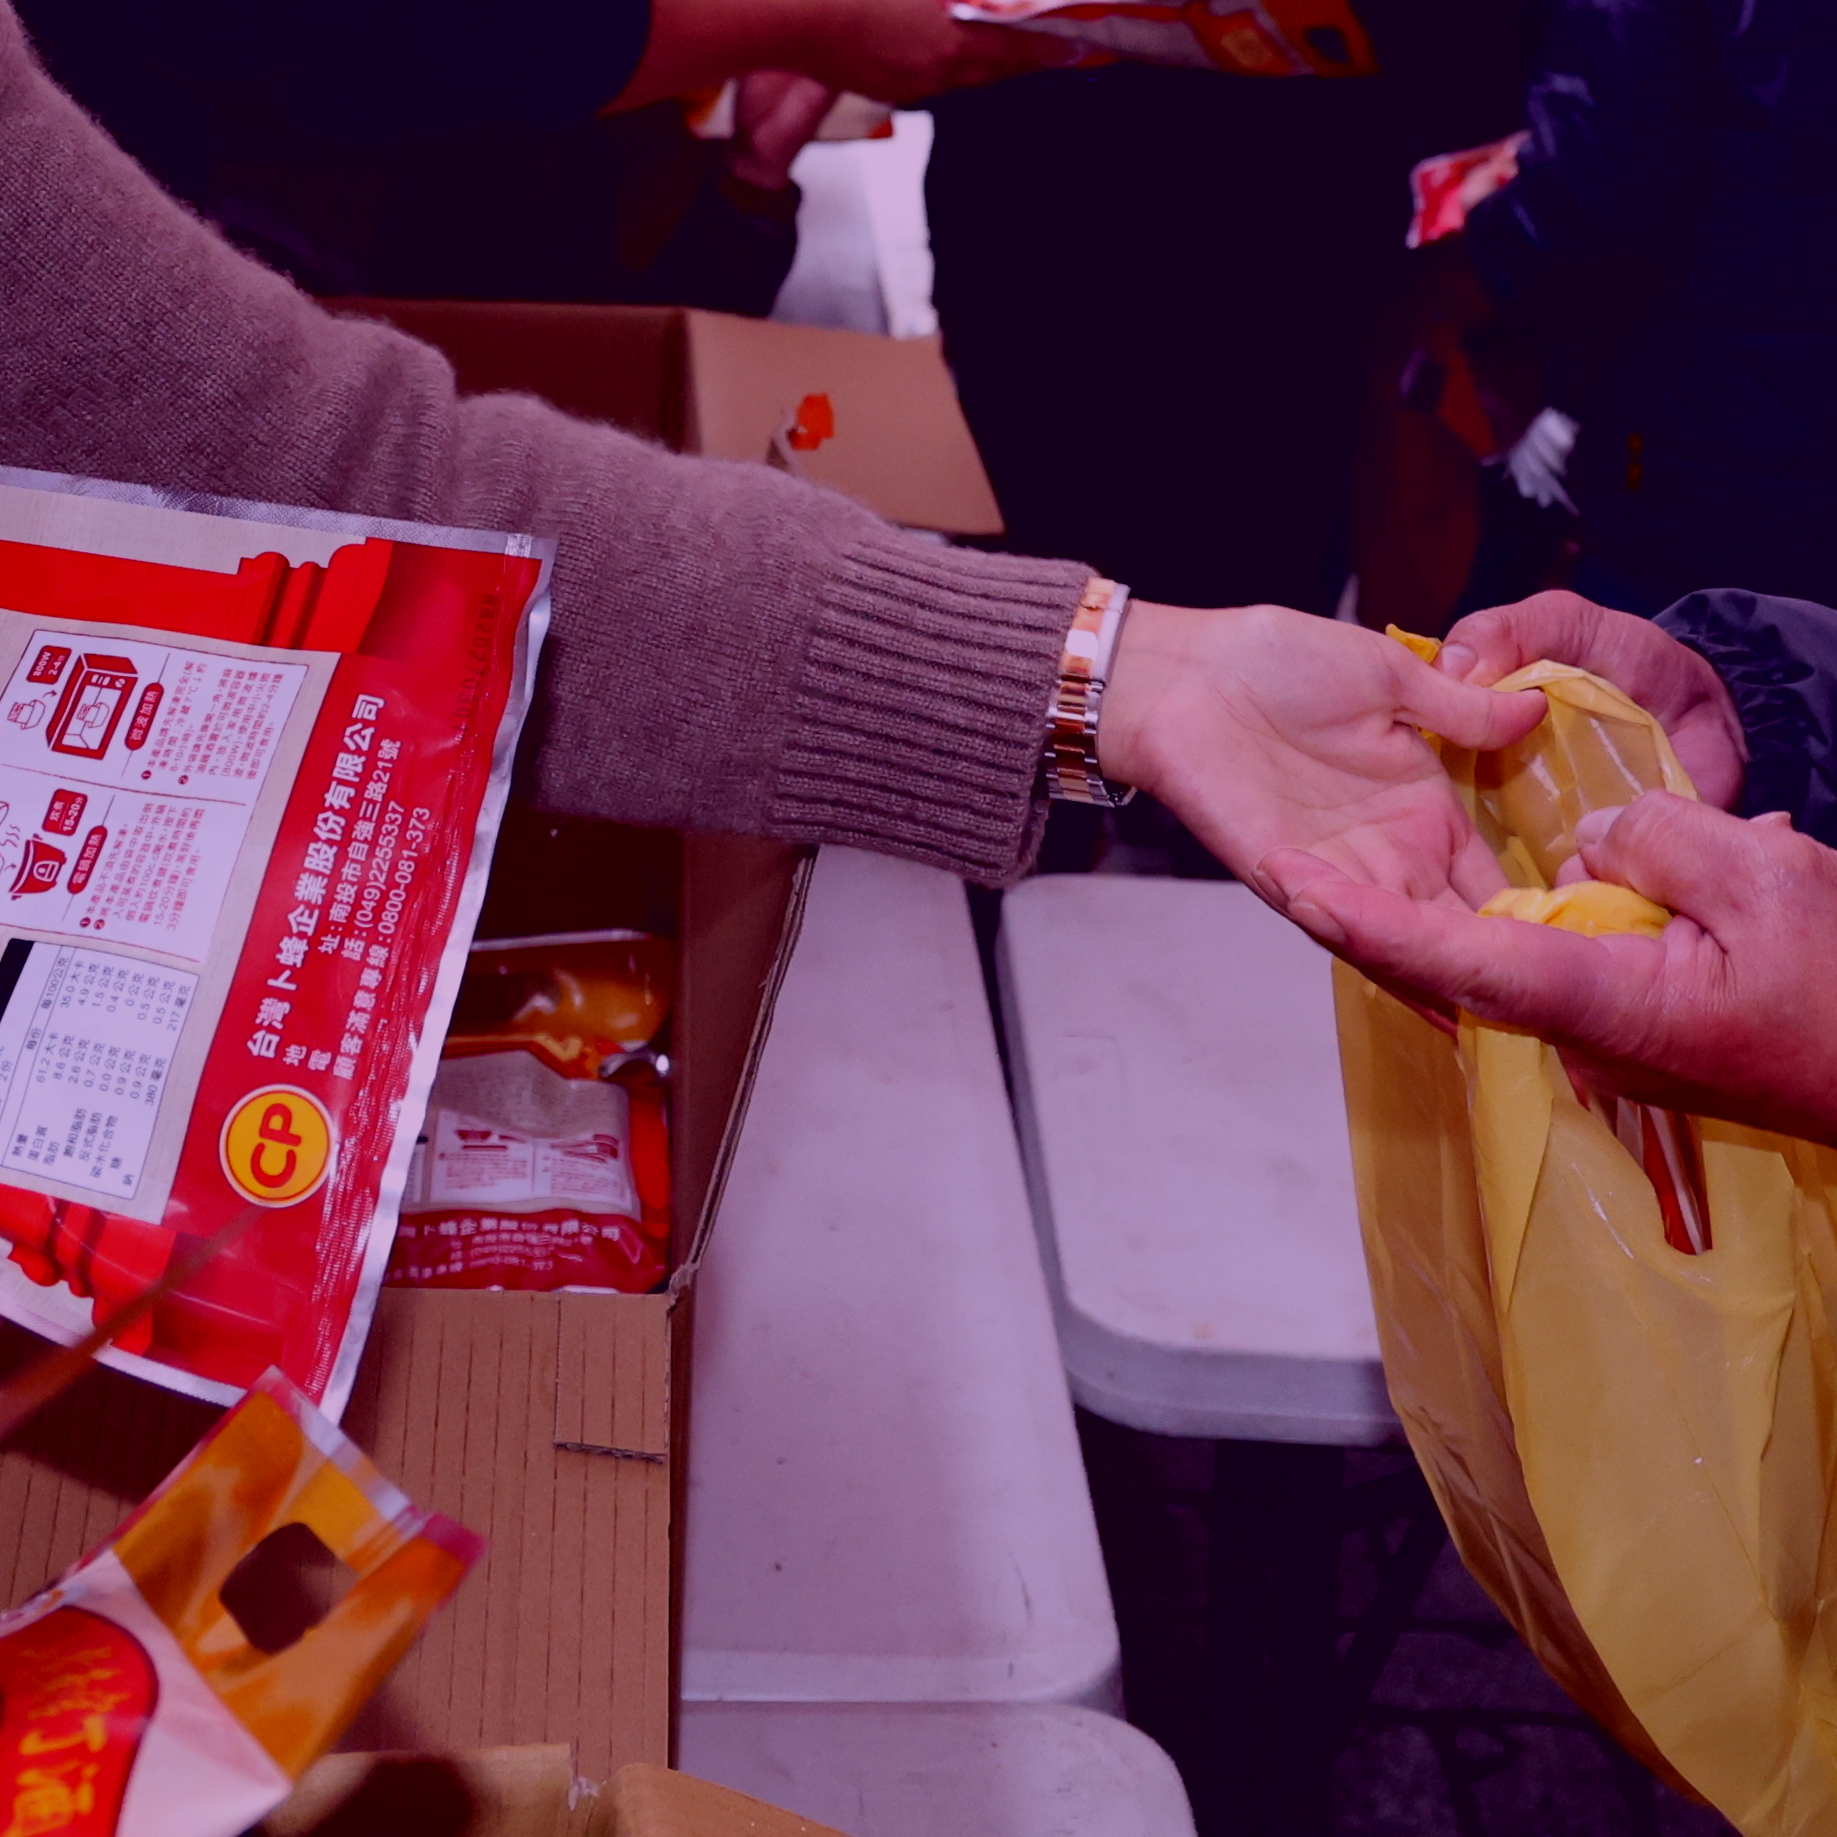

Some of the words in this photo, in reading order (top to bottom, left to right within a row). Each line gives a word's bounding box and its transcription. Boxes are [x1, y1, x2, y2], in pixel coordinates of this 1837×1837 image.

[31, 649, 53, 678] 800W
[129, 687, 160, 742] 微波加熱
[61, 794, 84, 833] 15-20分
[71, 830, 103, 886] 電鍋加熱
[244, 690, 386, 1061] 台灣卜蜂企業股份有限公司
[25, 1025, 42, 1051] 每份
[40, 954, 69, 1010] 每100公克
[281, 1040, 309, 1069] 地
[305, 1046, 333, 1074] 電
[243, 1099, 312, 1193] CP
